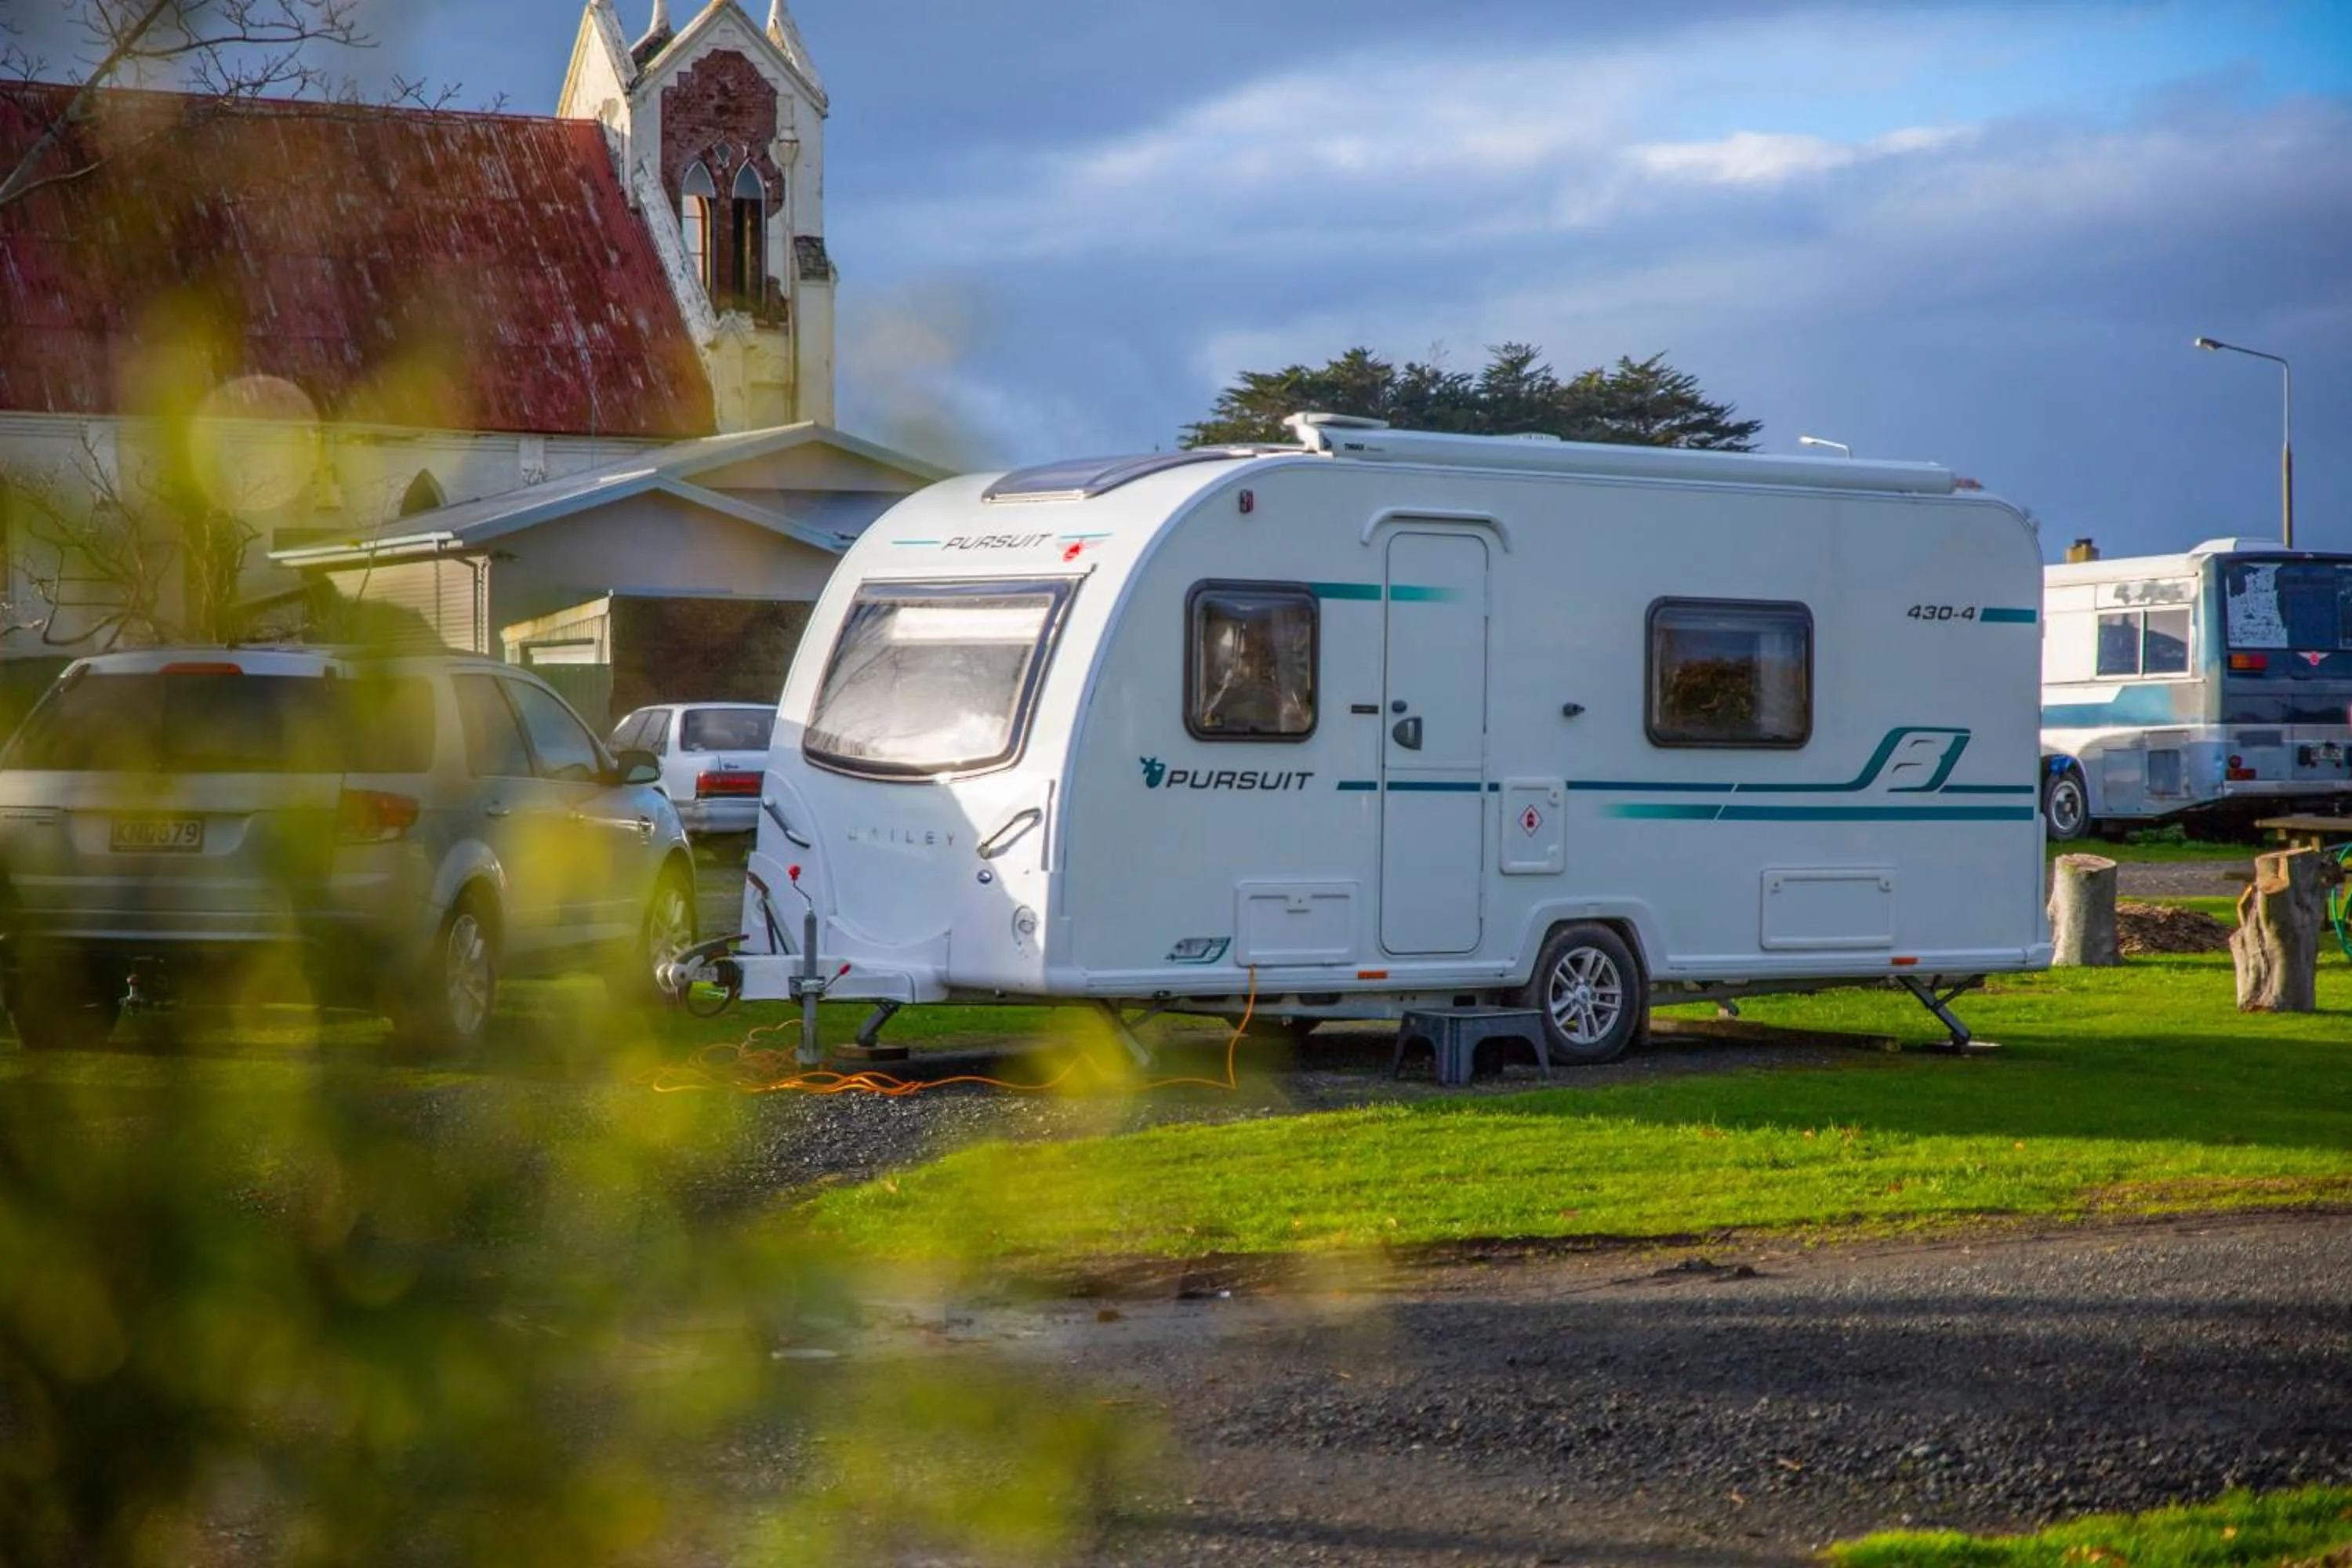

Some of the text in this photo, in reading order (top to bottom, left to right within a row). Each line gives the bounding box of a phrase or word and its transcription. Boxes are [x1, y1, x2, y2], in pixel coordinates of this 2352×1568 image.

[941, 533, 1053, 550] PURSUIT
[1907, 604, 1976, 621] 430-4
[1165, 769, 1316, 791] PURSUIT
